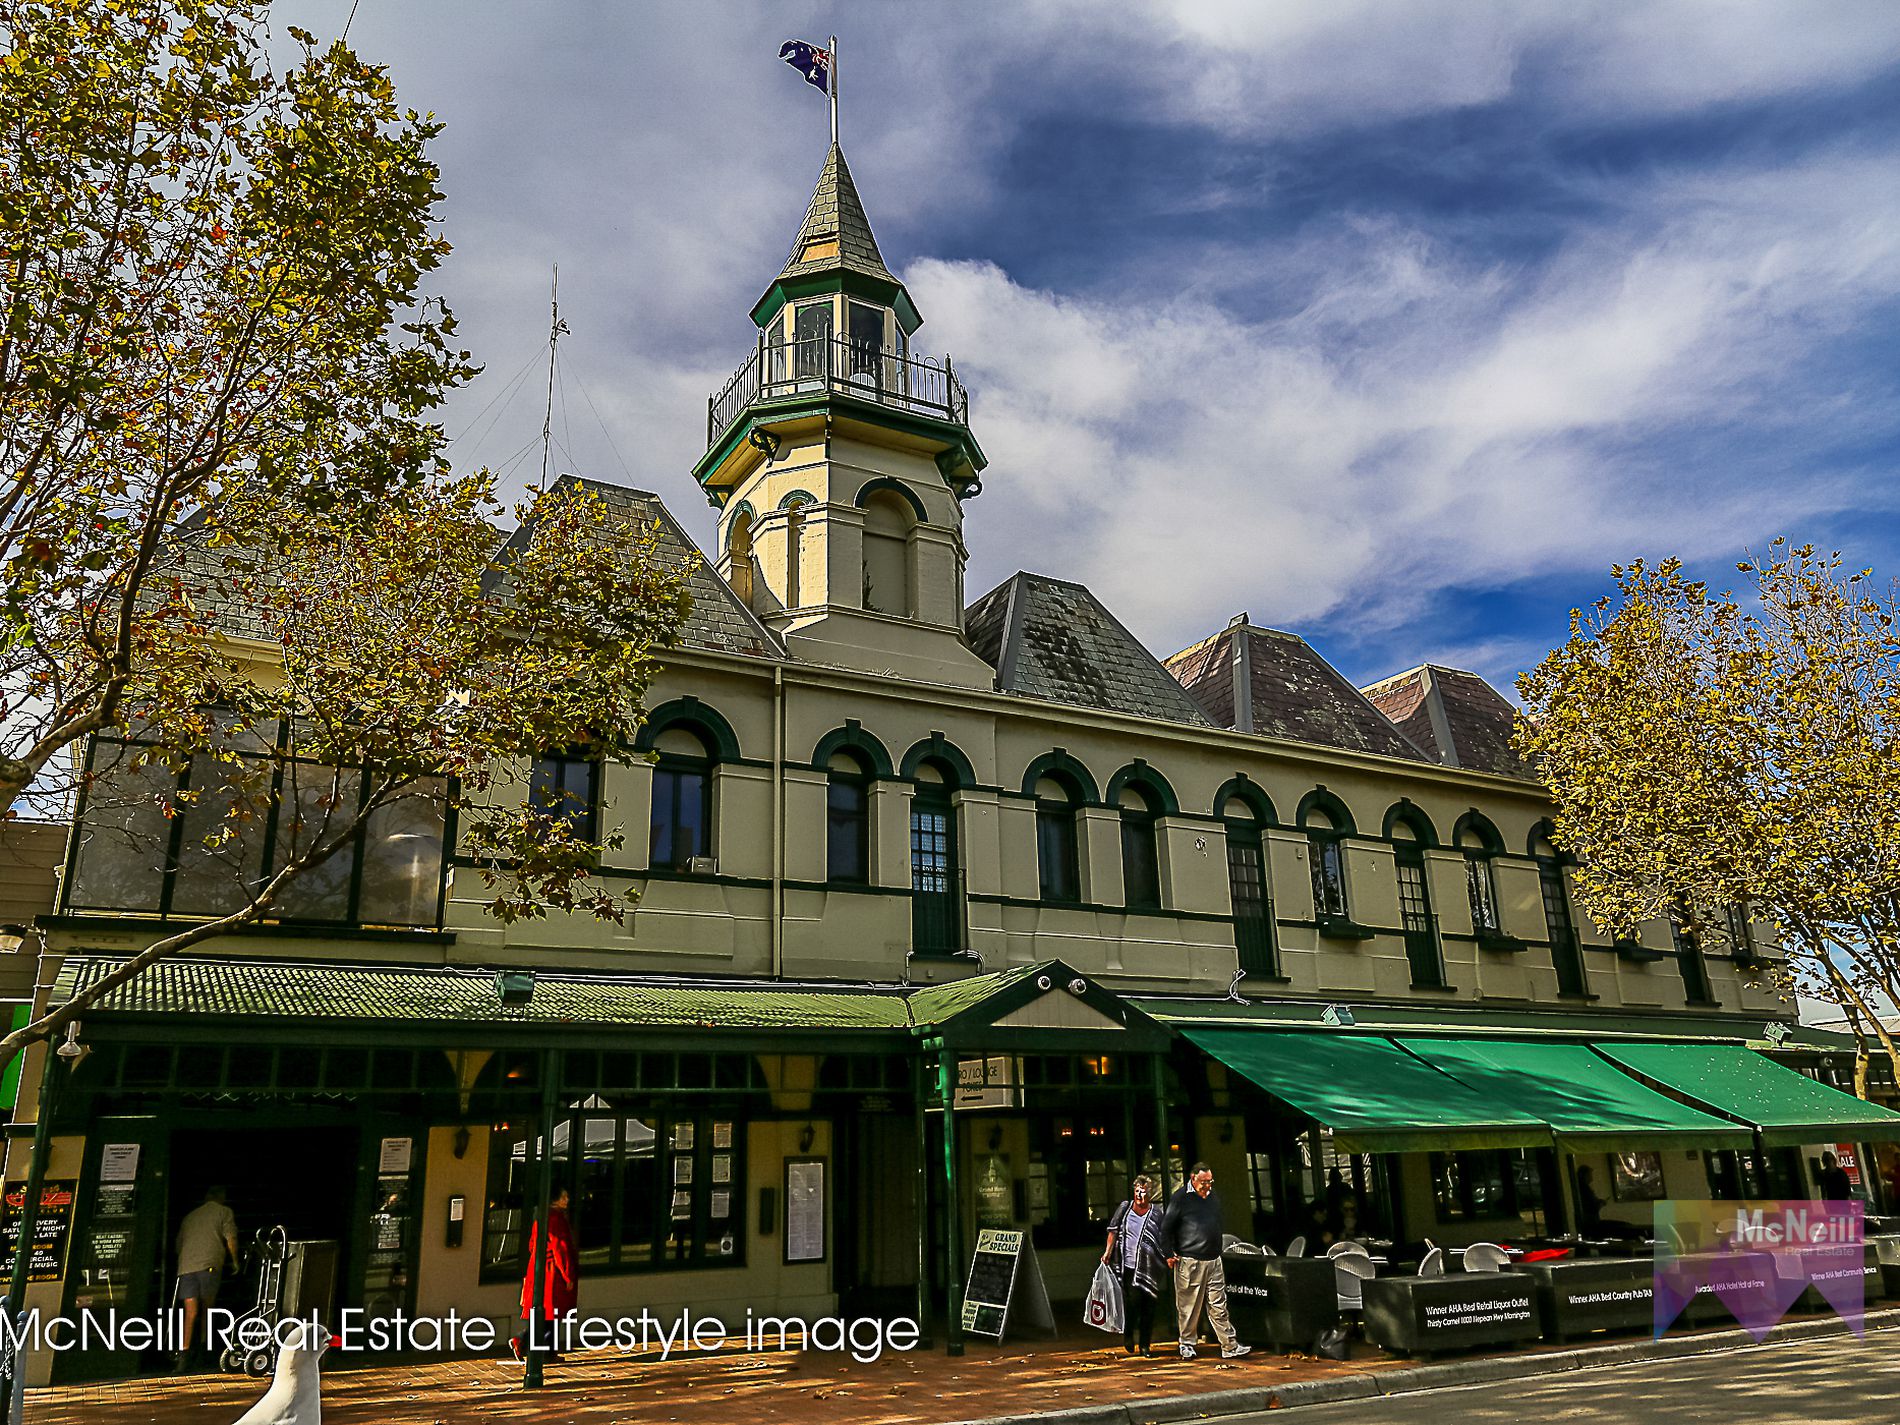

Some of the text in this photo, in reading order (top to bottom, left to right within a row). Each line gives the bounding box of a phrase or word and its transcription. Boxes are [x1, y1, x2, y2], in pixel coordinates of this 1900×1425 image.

[973, 1066, 997, 1079] LOUGE
[1840, 1156, 1855, 1167] ALE
[1244, 1286, 1253, 1295] the
[1254, 1287, 1268, 1297] Year
[1568, 1295, 1588, 1304] Winner
[1588, 1293, 1601, 1302] AHA
[1601, 1292, 1612, 1301] Best
[1425, 1298, 1529, 1316] Winner AHA Best Retail Liquor Outlet
